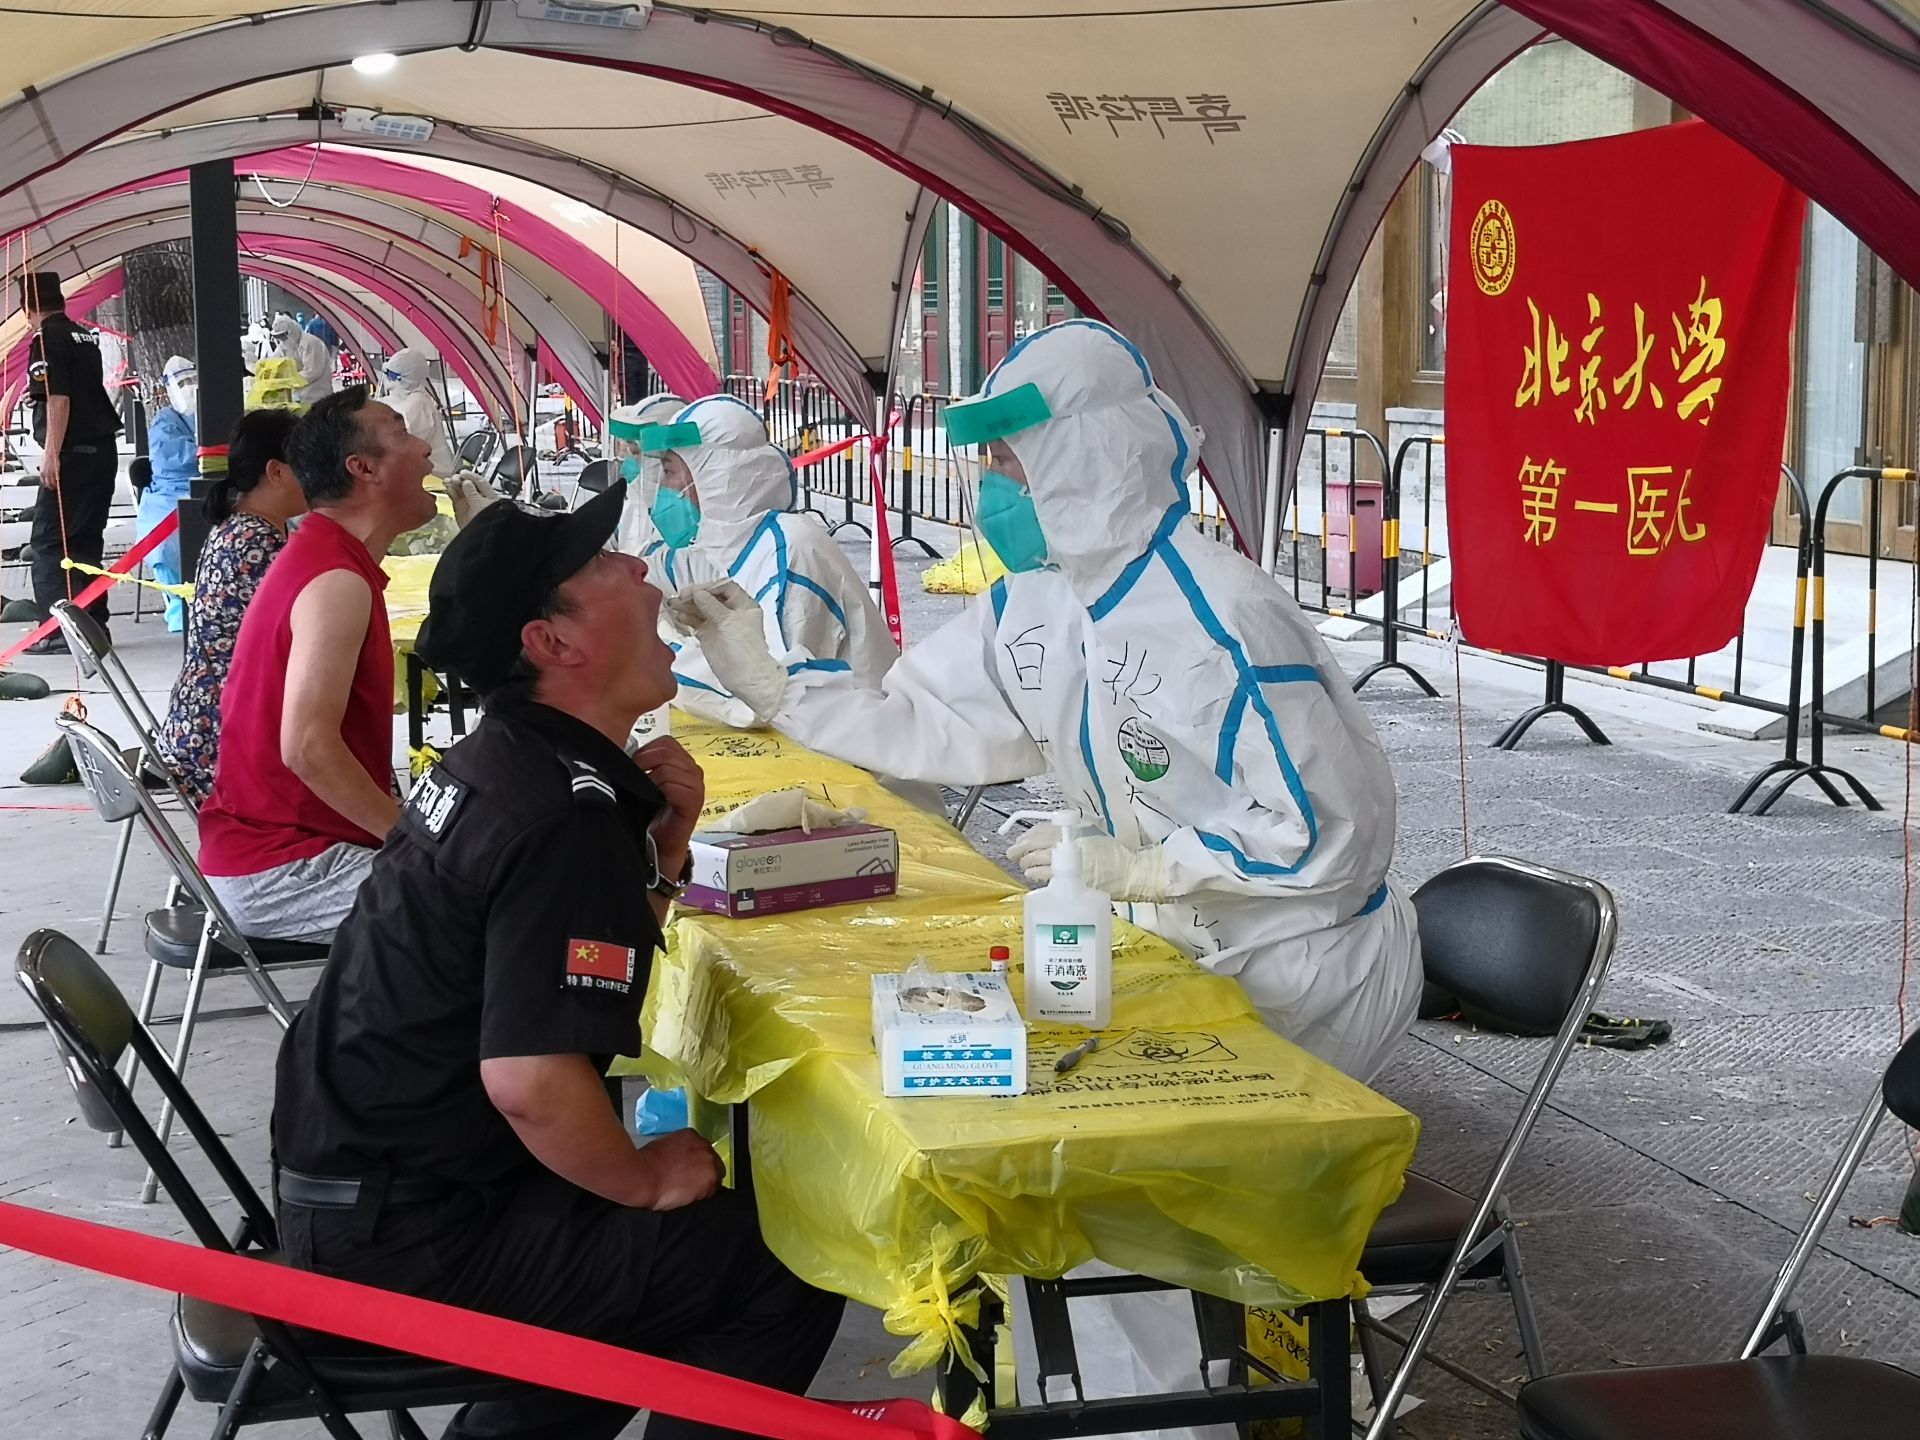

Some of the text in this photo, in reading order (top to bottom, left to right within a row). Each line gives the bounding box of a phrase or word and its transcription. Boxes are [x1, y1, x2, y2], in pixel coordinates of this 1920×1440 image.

[742, 890, 749, 900] L
[1044, 964, 1088, 977] 手消毒液
